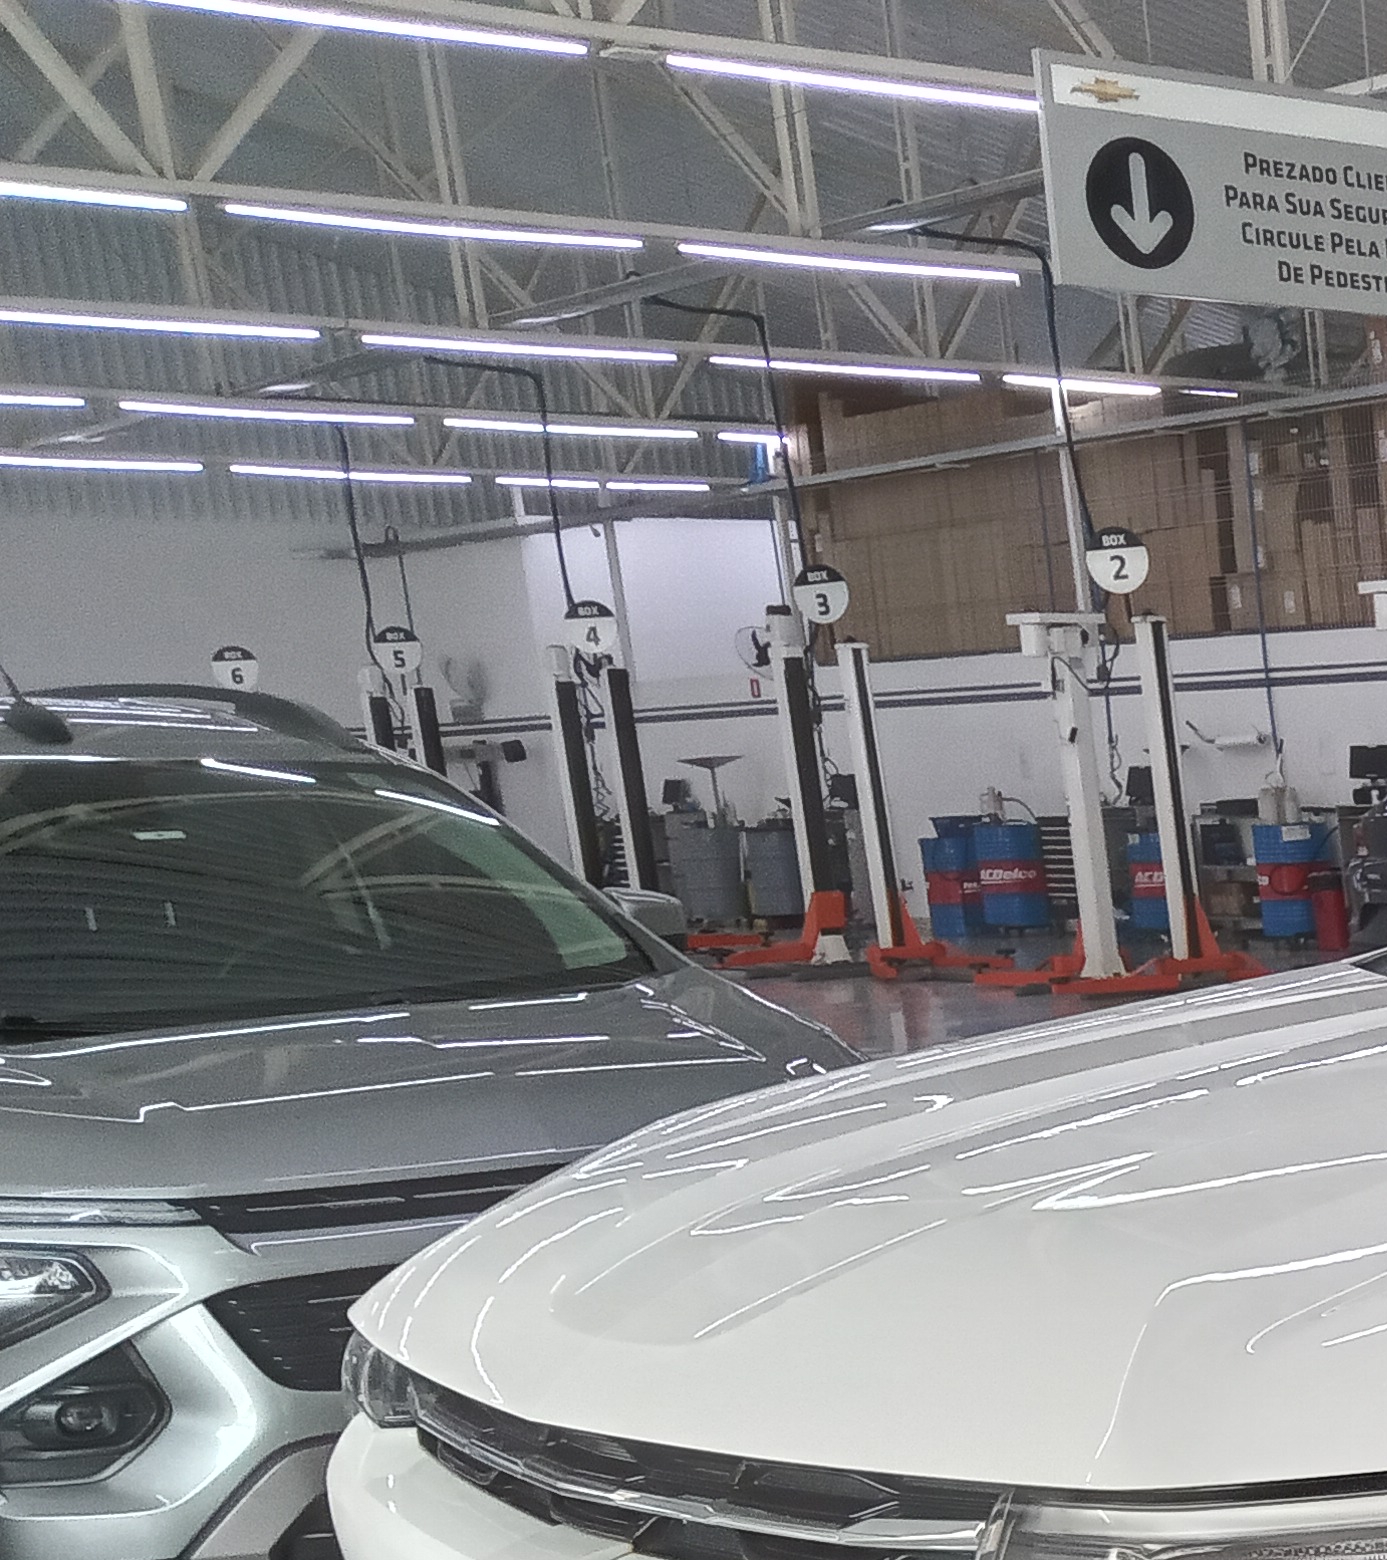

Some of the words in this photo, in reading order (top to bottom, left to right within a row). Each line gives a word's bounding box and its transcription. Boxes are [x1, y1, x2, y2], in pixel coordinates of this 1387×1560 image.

[1243, 151, 1337, 185] PREZADO
[1224, 185, 1279, 213] PARA
[1285, 192, 1325, 218] SUA
[1241, 222, 1325, 251] CIRCULE
[1330, 232, 1380, 259] PELA
[1278, 260, 1304, 284] DE
[1101, 534, 1127, 546] BOX
[807, 570, 829, 582] BOX
[1109, 555, 1129, 581] 2
[577, 605, 600, 617] BOX
[814, 593, 830, 616] 3
[585, 626, 602, 646] 4
[392, 650, 406, 668] 5
[230, 667, 244, 685] 6
